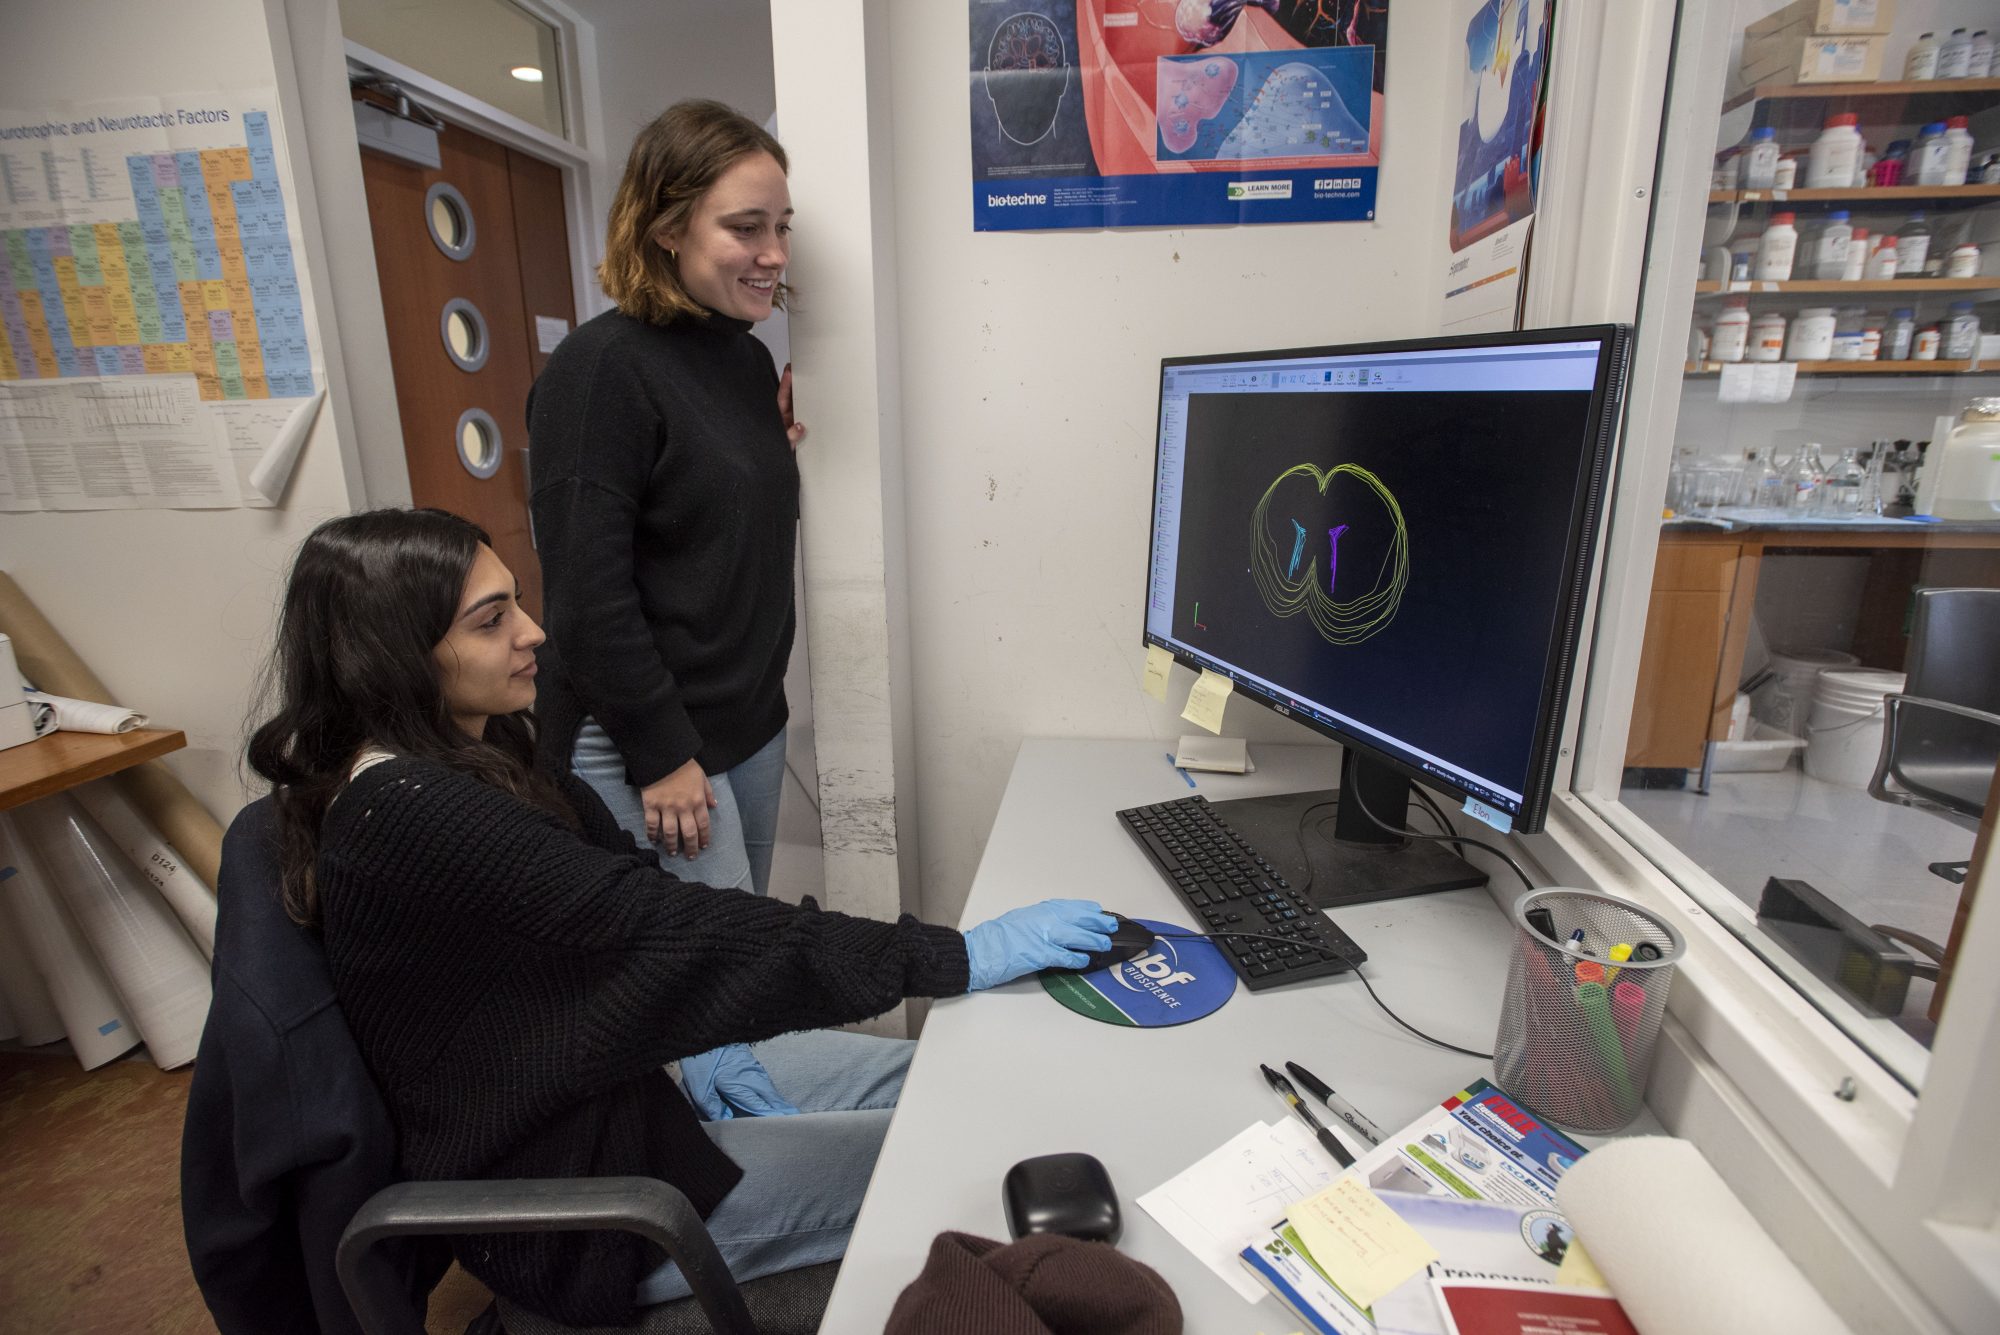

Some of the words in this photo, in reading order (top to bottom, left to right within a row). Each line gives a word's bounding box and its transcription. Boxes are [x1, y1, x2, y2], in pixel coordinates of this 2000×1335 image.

[0, 121, 68, 140] urotrophic
[71, 119, 96, 134] and
[99, 112, 175, 132] Neurotactic
[176, 109, 230, 124] Factors
[1314, 191, 1361, 199] bio-techne.com
[1273, 704, 1290, 716] ASUS
[1124, 966, 1182, 1009] BIOSCIENCE
[1457, 1110, 1479, 1131] Your
[1478, 1125, 1512, 1152] choice
[1473, 1102, 1526, 1141] Equipment
[1481, 1095, 1542, 1136] FREE
